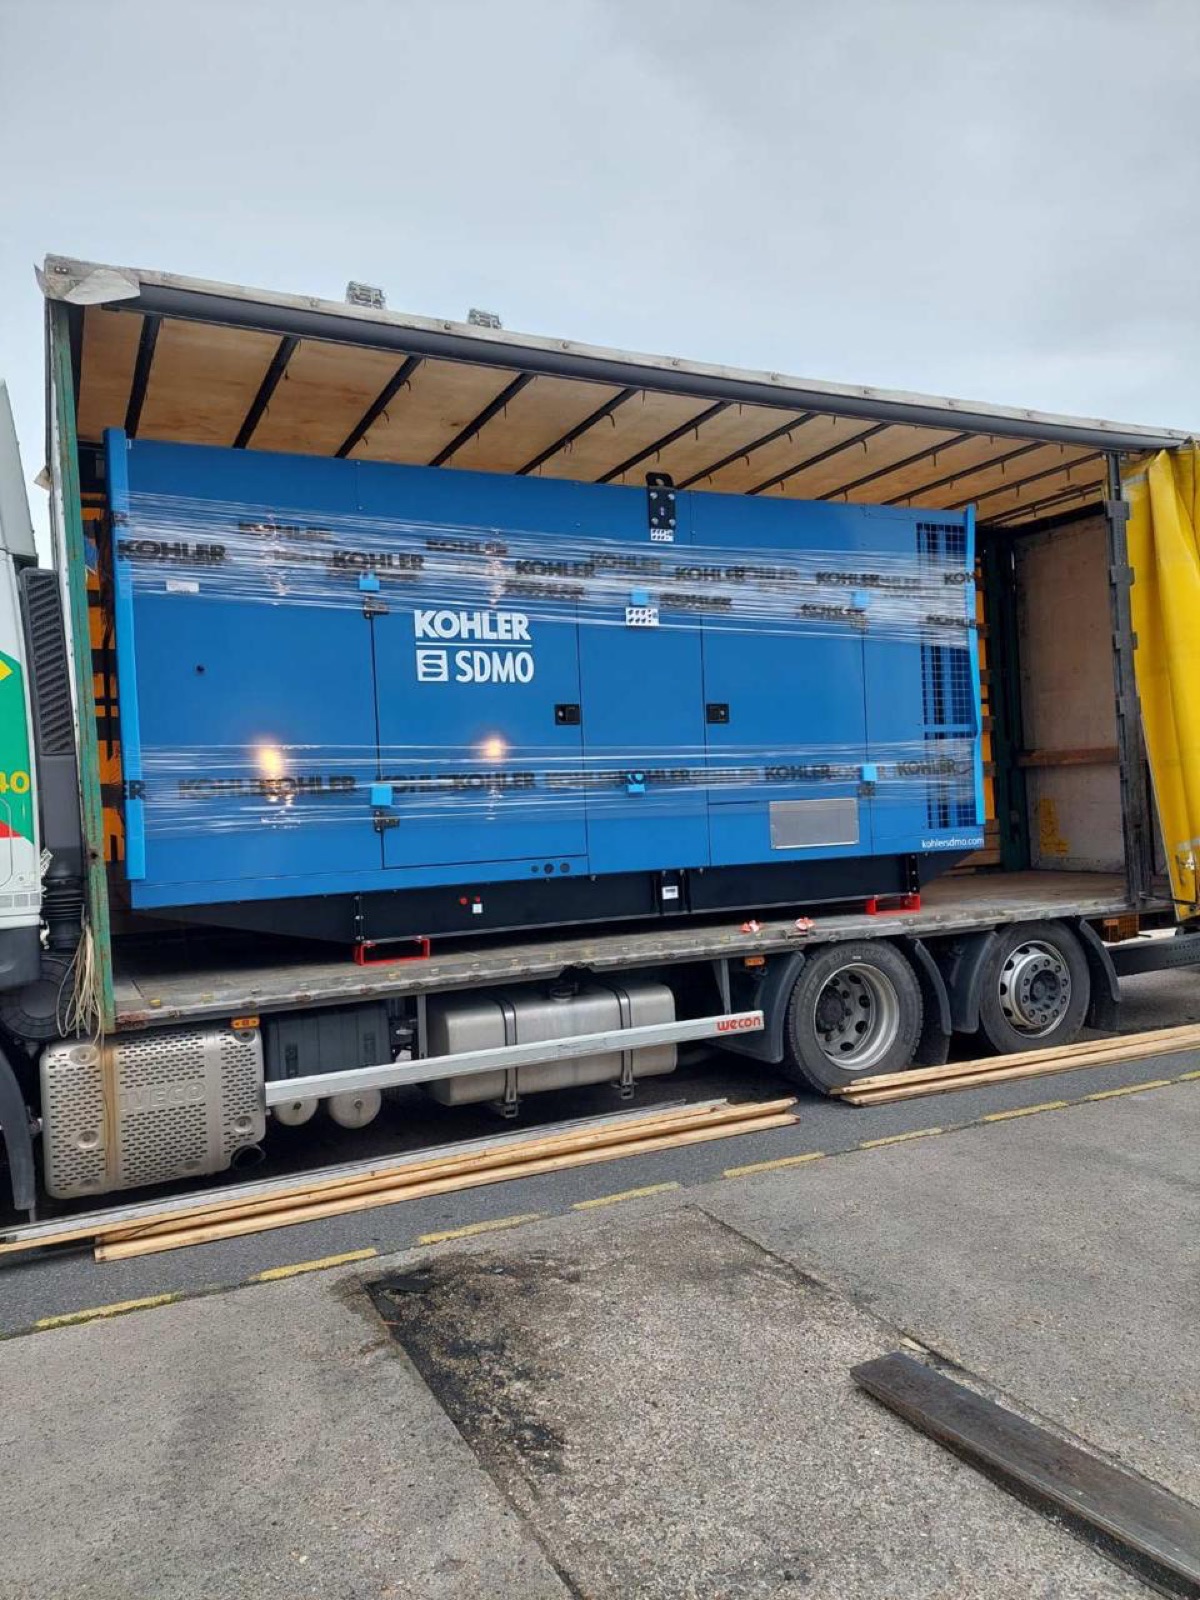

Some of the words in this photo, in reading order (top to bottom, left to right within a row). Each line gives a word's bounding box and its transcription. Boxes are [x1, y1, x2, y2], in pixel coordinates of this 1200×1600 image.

[117, 539, 226, 561] KOHLER
[332, 551, 424, 570] KOHLER
[515, 560, 595, 577] KOHLER
[675, 566, 745, 581] KOHLER
[815, 571, 880, 587] KOHLER
[414, 609, 531, 640] KOHLER
[455, 650, 534, 683] SDMO
[765, 765, 830, 780] KOHLER
[897, 760, 955, 776] KOHLER
[921, 837, 984, 849] kohlersdmo.com
[717, 1016, 761, 1031] wecon
